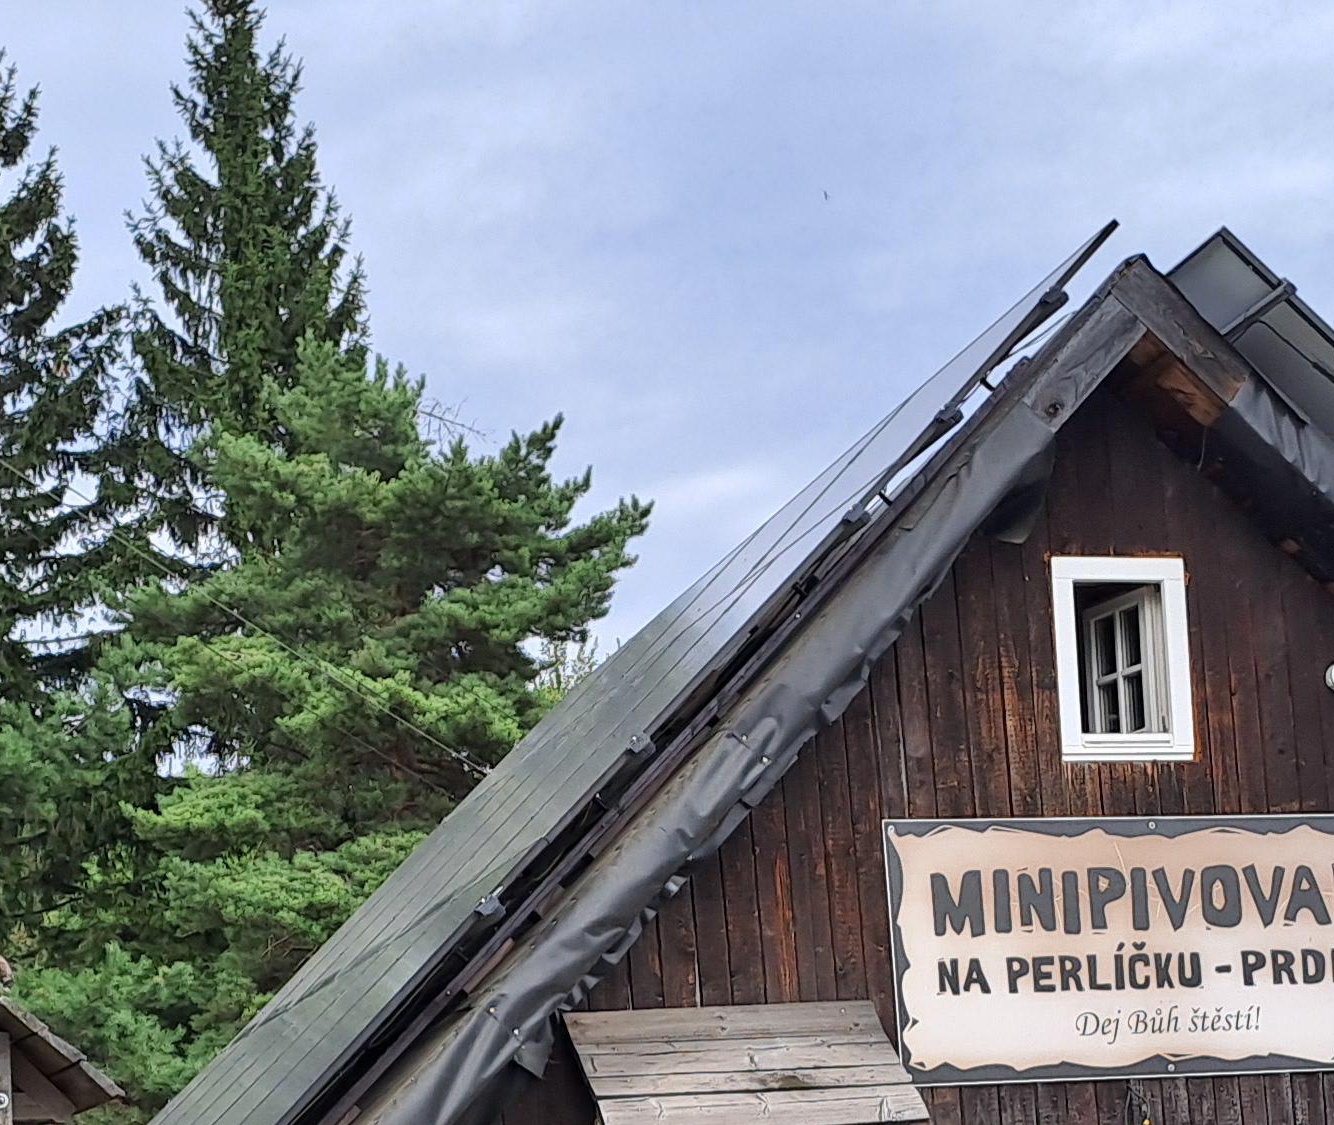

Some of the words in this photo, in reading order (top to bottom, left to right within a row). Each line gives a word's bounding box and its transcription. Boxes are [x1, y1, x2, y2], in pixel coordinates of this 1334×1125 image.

[937, 957, 991, 995] NA
[1006, 941, 1202, 994] PERLÍČKU
[1075, 1009, 1121, 1045] Dej
[1127, 1005, 1180, 1034] Bůh
[1188, 1005, 1261, 1034] štěstí!
